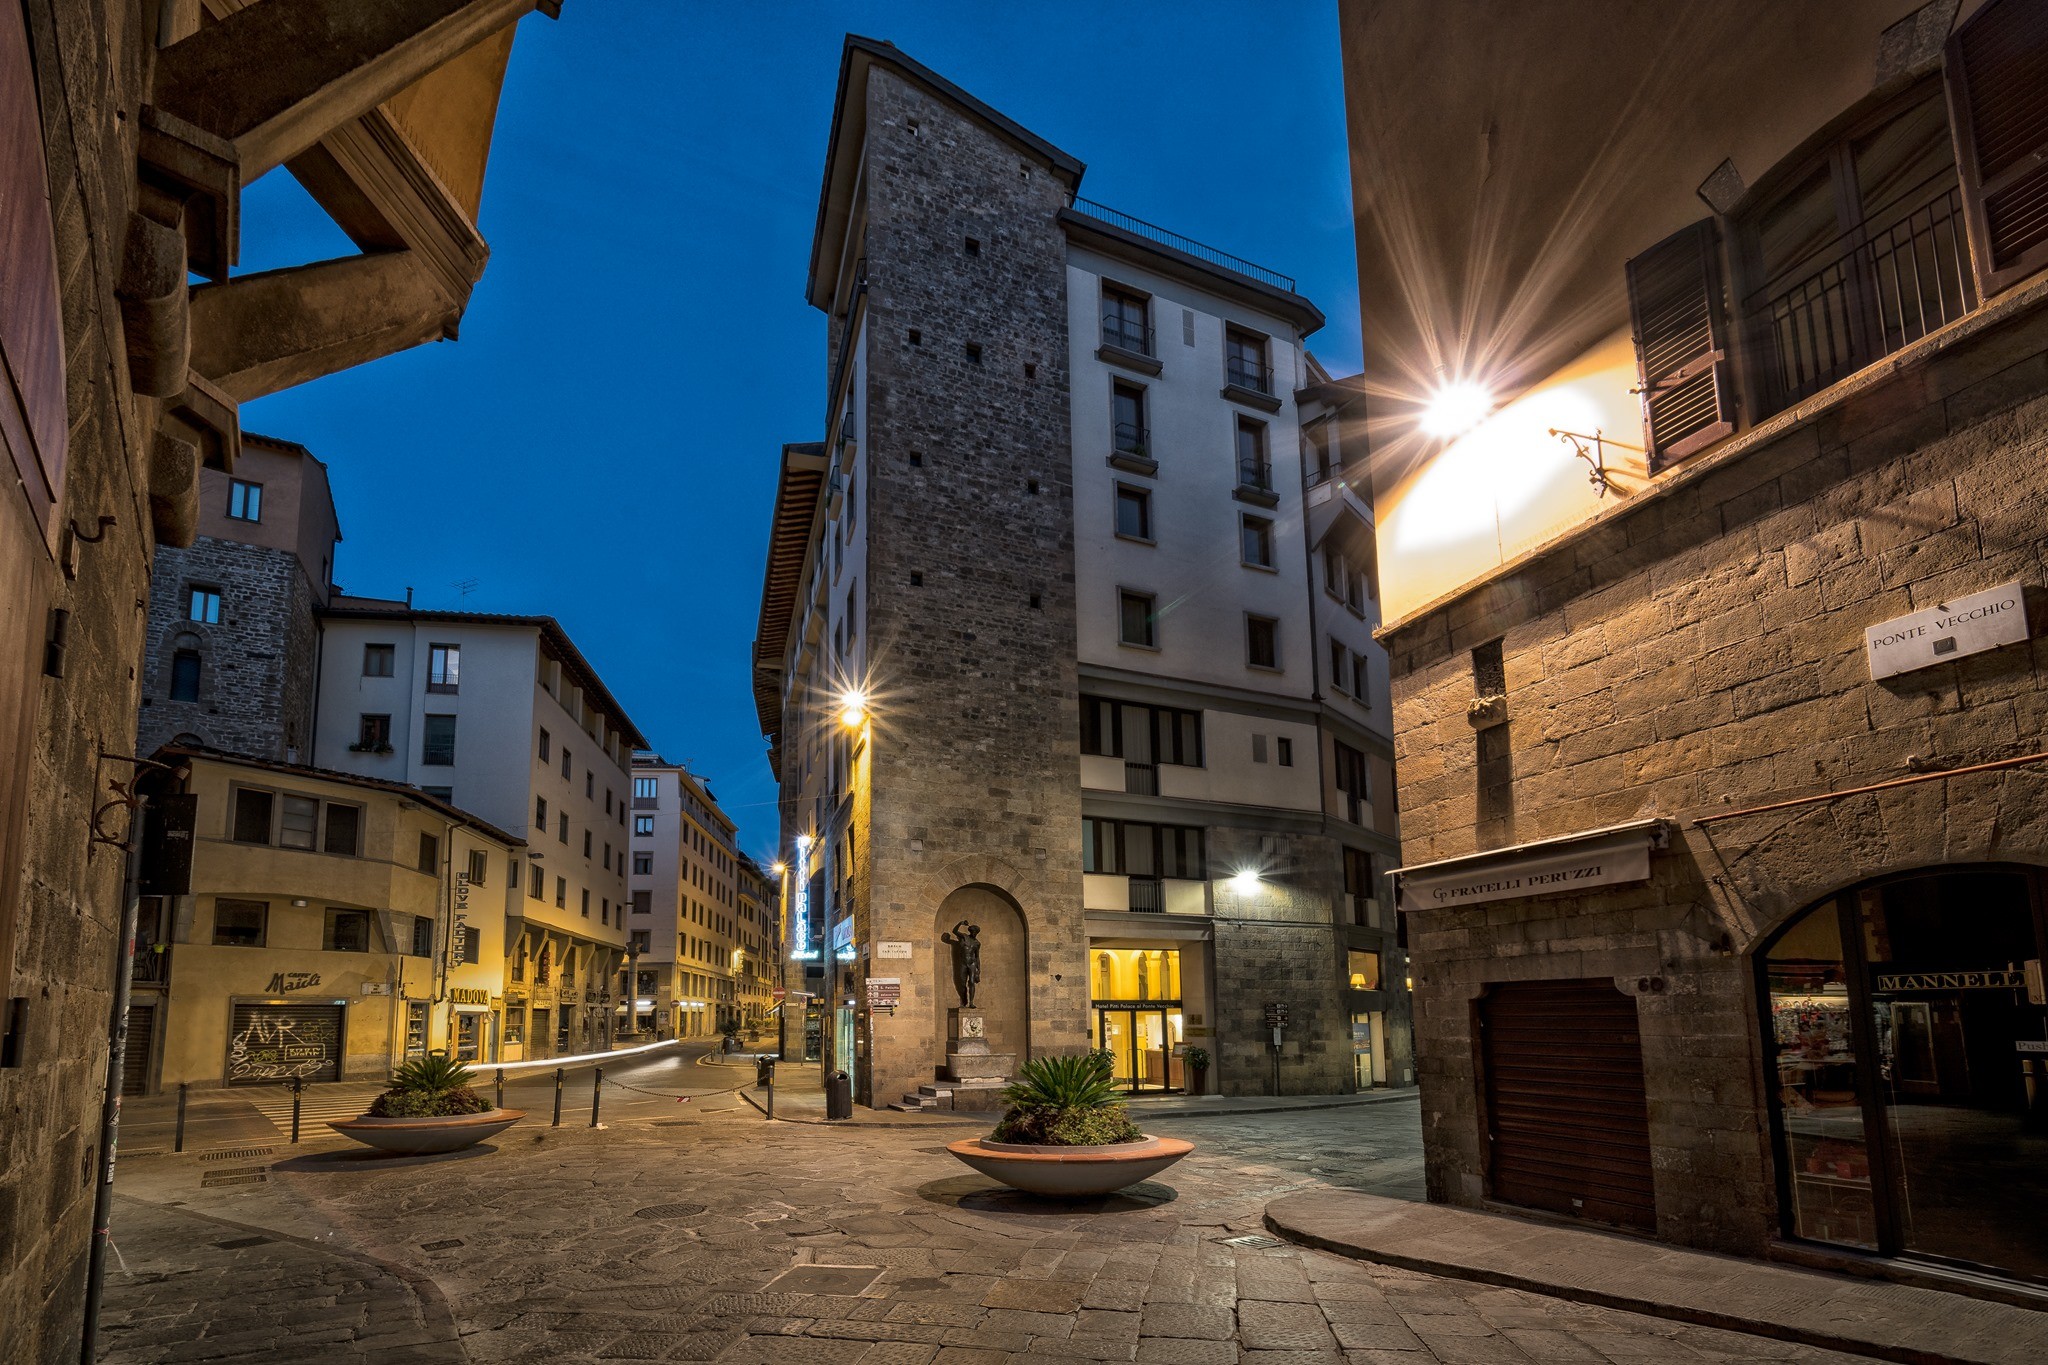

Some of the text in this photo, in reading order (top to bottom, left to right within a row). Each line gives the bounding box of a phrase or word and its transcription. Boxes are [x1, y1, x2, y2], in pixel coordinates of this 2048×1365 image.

[1873, 599, 2016, 649] PONTE VECCHIO
[455, 872, 469, 909] GLOVE
[1450, 878, 1521, 898] FRATELLI
[1527, 866, 1602, 887] PERUZZI
[450, 988, 488, 1004] MADOVA
